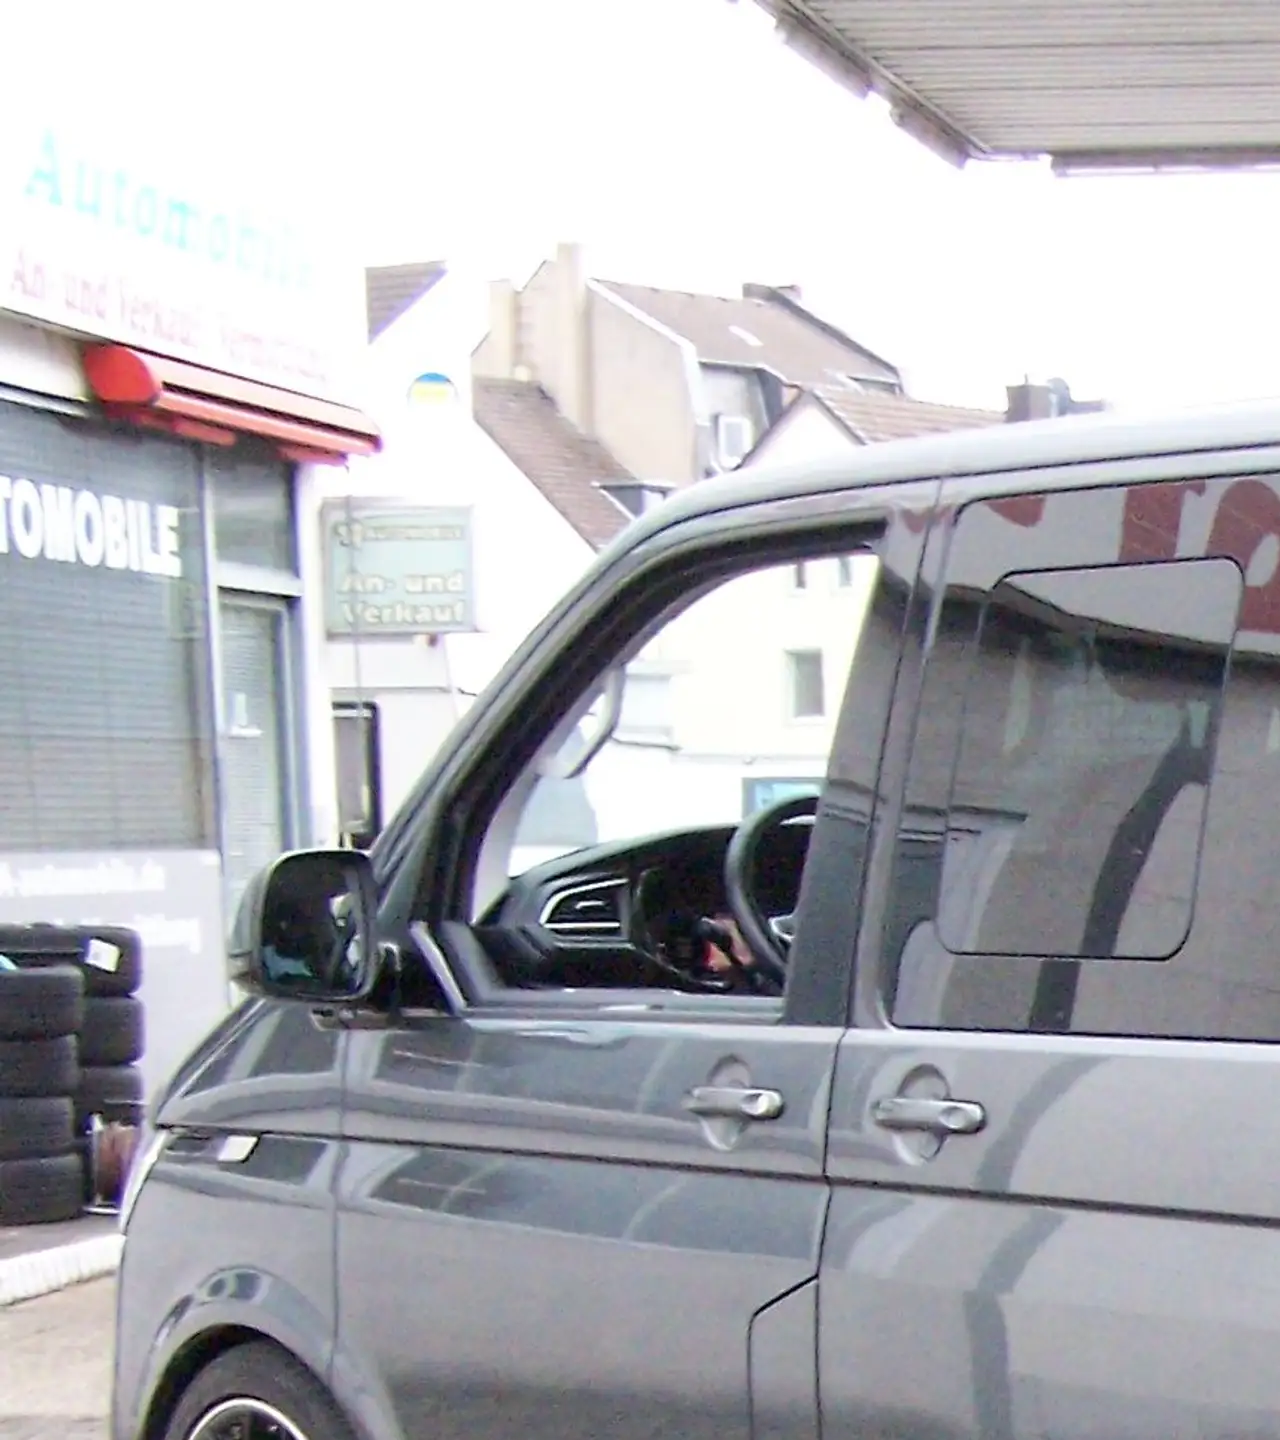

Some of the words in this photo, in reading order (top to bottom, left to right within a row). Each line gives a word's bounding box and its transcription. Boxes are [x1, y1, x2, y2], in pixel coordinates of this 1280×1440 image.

[337, 572, 395, 596] An-
[405, 568, 467, 596] und
[338, 599, 467, 627] Verkauf
